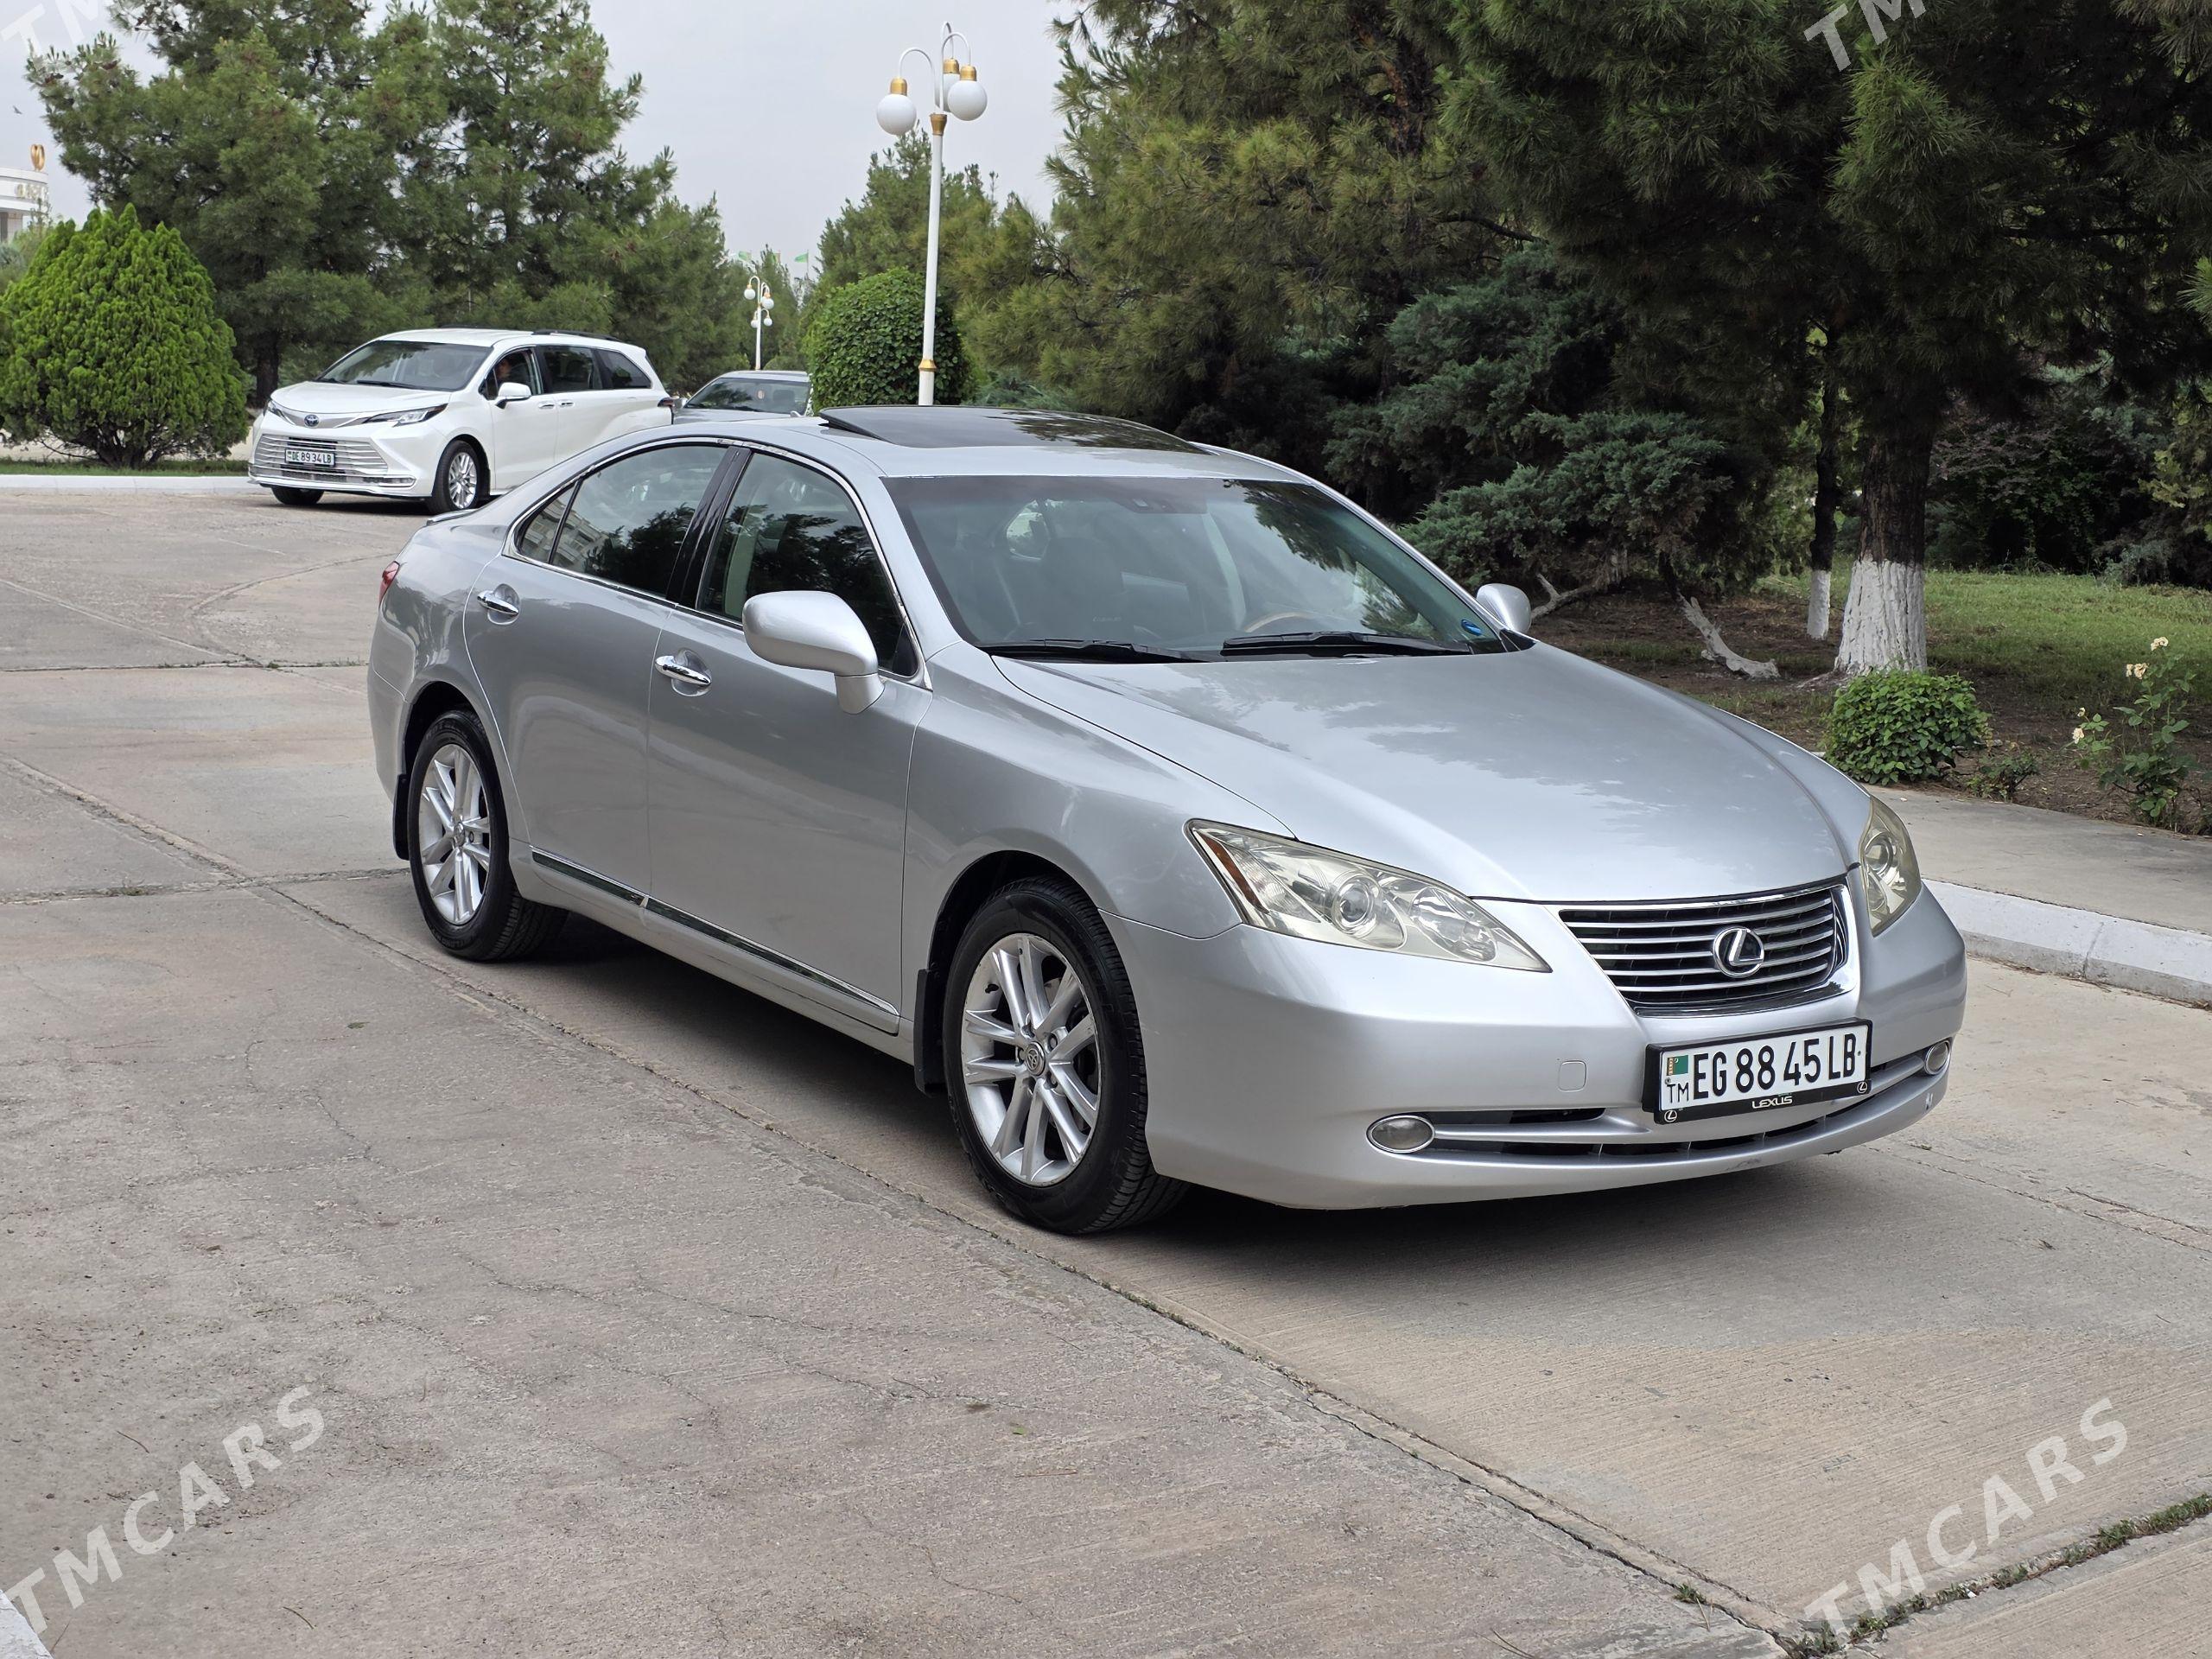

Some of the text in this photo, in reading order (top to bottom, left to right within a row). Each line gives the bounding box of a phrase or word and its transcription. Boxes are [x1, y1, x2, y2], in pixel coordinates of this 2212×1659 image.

[301, 452, 311, 462] 89
[312, 453, 321, 462] 34
[322, 454, 332, 464] LB
[1693, 1033, 1857, 1100] EG 88 45 LB
[1666, 1082, 1690, 1104] TM
[1751, 1095, 1793, 1109] LEXUS
